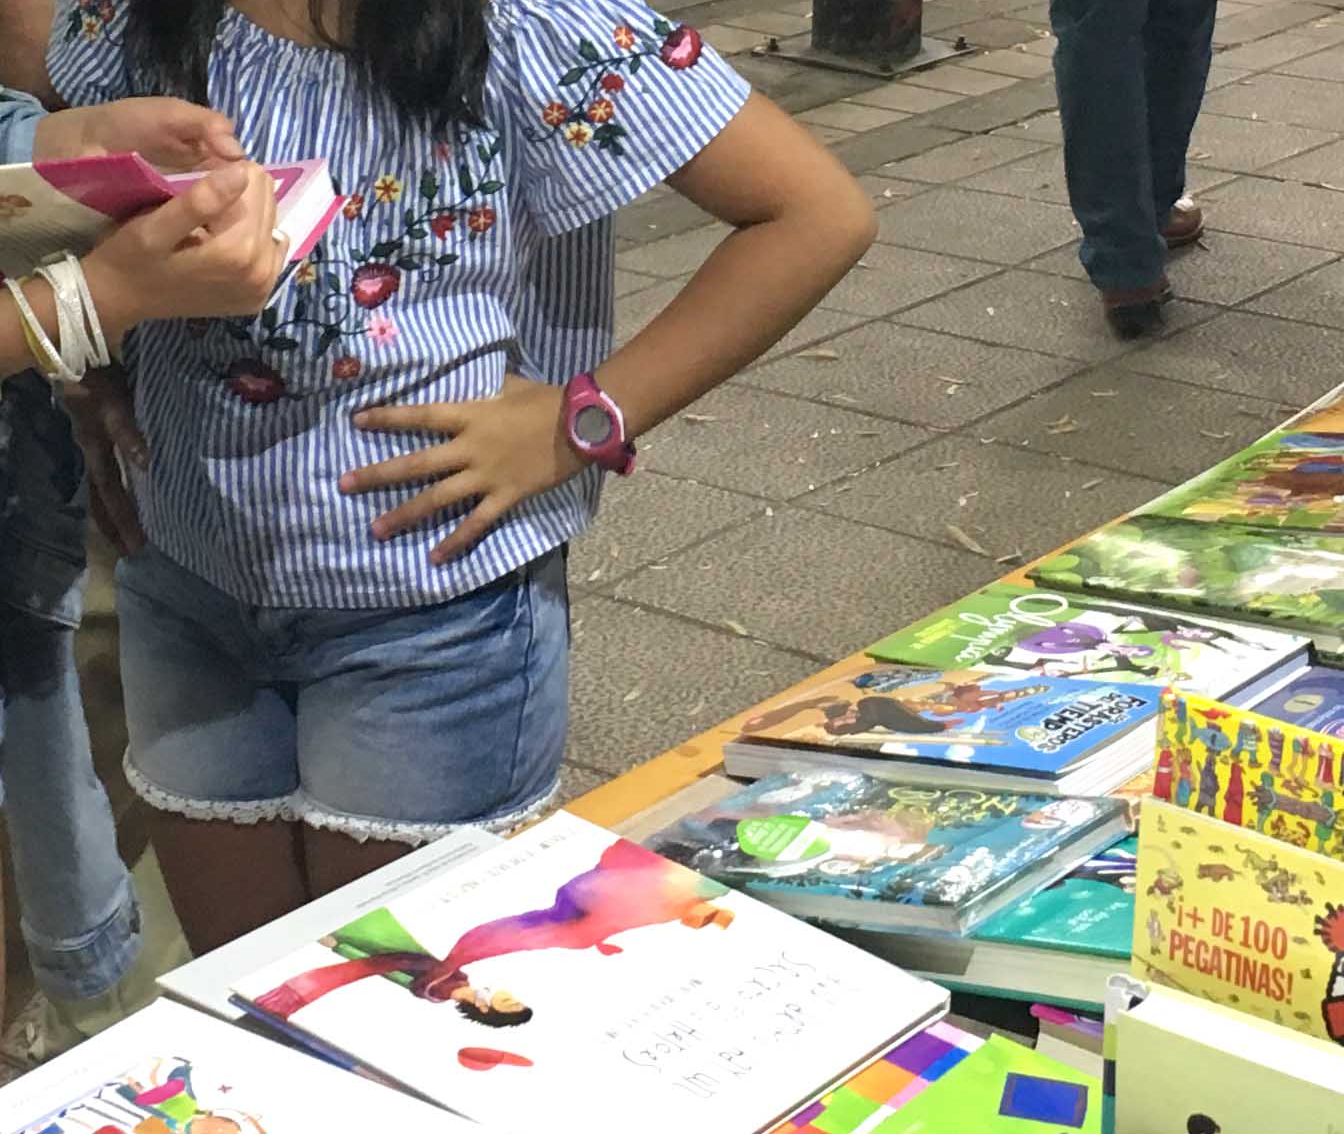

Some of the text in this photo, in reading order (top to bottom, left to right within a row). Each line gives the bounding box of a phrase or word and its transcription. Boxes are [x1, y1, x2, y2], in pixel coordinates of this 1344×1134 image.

[1211, 906, 1235, 942] DE
[1239, 916, 1288, 961] 100
[1169, 929, 1294, 1005] PEGATINAS!
